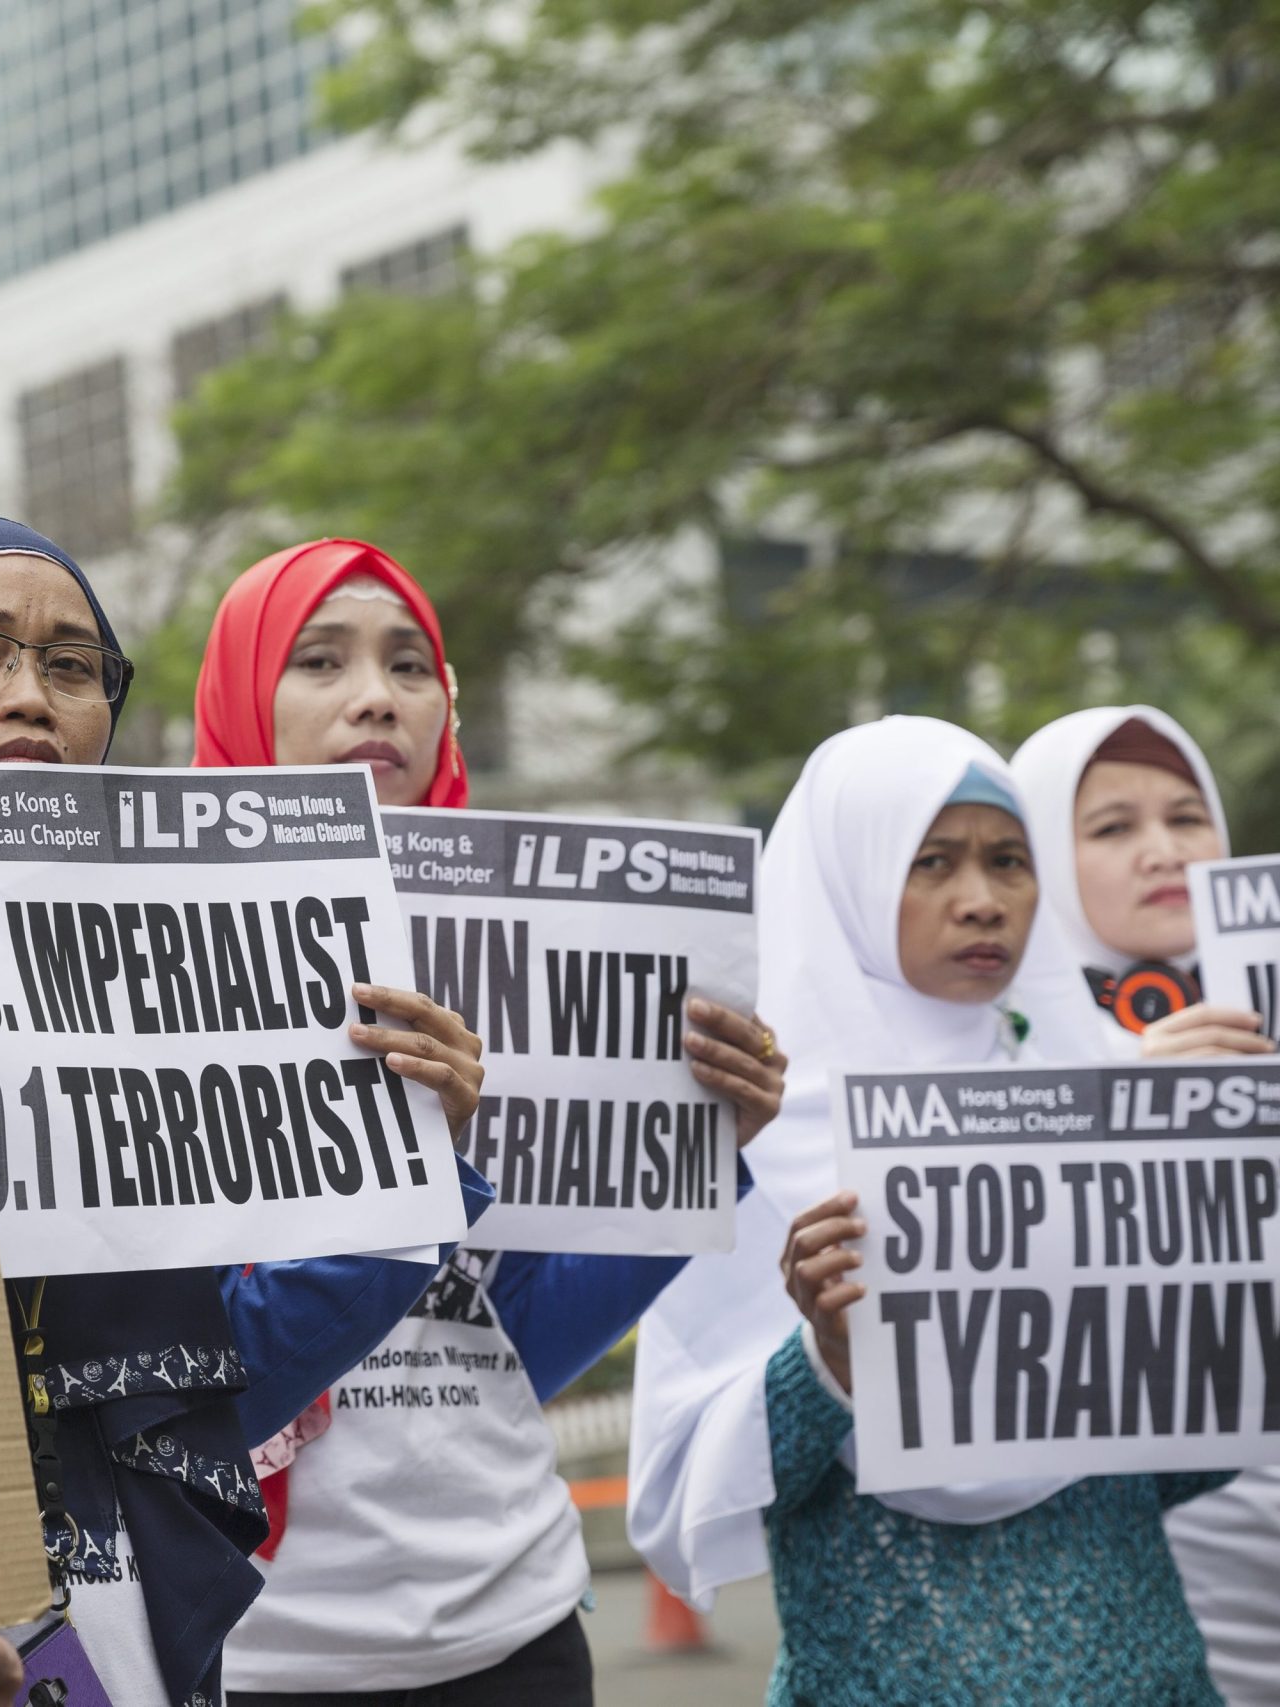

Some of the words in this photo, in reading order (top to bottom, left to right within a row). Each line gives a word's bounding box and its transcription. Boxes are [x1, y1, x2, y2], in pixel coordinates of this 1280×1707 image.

[16, 791, 61, 818] Kong
[65, 792, 79, 814] &
[267, 796, 302, 818] Hong
[302, 795, 334, 816] Kong
[335, 797, 346, 815] &
[31, 823, 101, 850] Chapter
[272, 824, 316, 844] Macau
[318, 822, 366, 843] Chapter
[383, 834, 404, 856] ng
[408, 832, 454, 857] Kong
[458, 835, 473, 855] &
[418, 860, 494, 886] Chapter
[1214, 872, 1280, 927] IM
[5, 896, 378, 1035] IMPERIALIST
[410, 915, 530, 1055] WN
[546, 948, 689, 1060] WITH
[851, 1082, 961, 1139] IMA
[958, 1087, 1007, 1110] Hong
[1010, 1085, 1056, 1109] Kong
[1058, 1084, 1074, 1104] &
[57, 1057, 430, 1209] TERRORIST!
[962, 1114, 1020, 1134] Macau
[1023, 1111, 1095, 1135] Chapter
[460, 1095, 719, 1211] ERIALISM!
[885, 1163, 1046, 1274] STOP
[1061, 1156, 1280, 1268] TRUMP
[444, 1346, 498, 1373] Migrant
